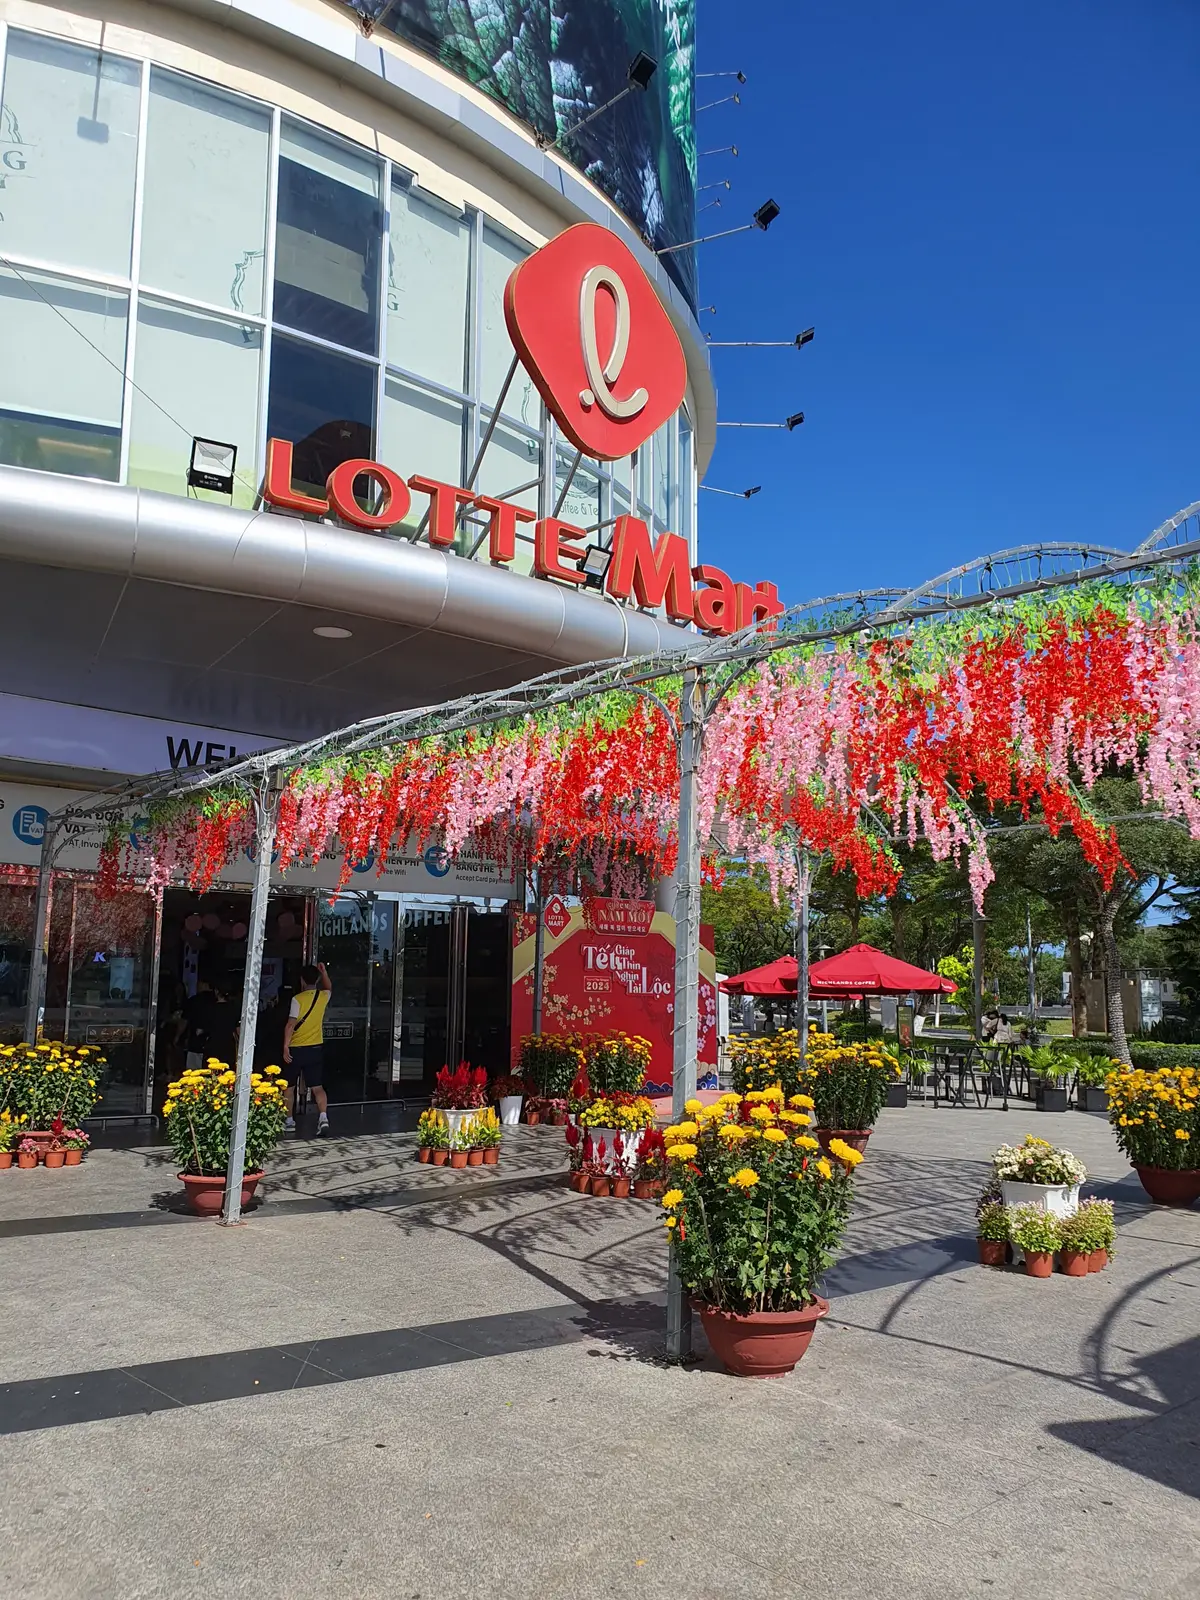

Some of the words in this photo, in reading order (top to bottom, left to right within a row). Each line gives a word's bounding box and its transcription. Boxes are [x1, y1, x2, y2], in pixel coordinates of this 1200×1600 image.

[559, 500, 579, 515] offee
[264, 437, 588, 584] LOTTE
[607, 514, 785, 637] Mart
[455, 874, 475, 882] Accept
[319, 912, 388, 938] IGHLANDS
[548, 920, 565, 928] MART
[586, 982, 609, 991] 2024
[641, 966, 671, 999] Lộc
